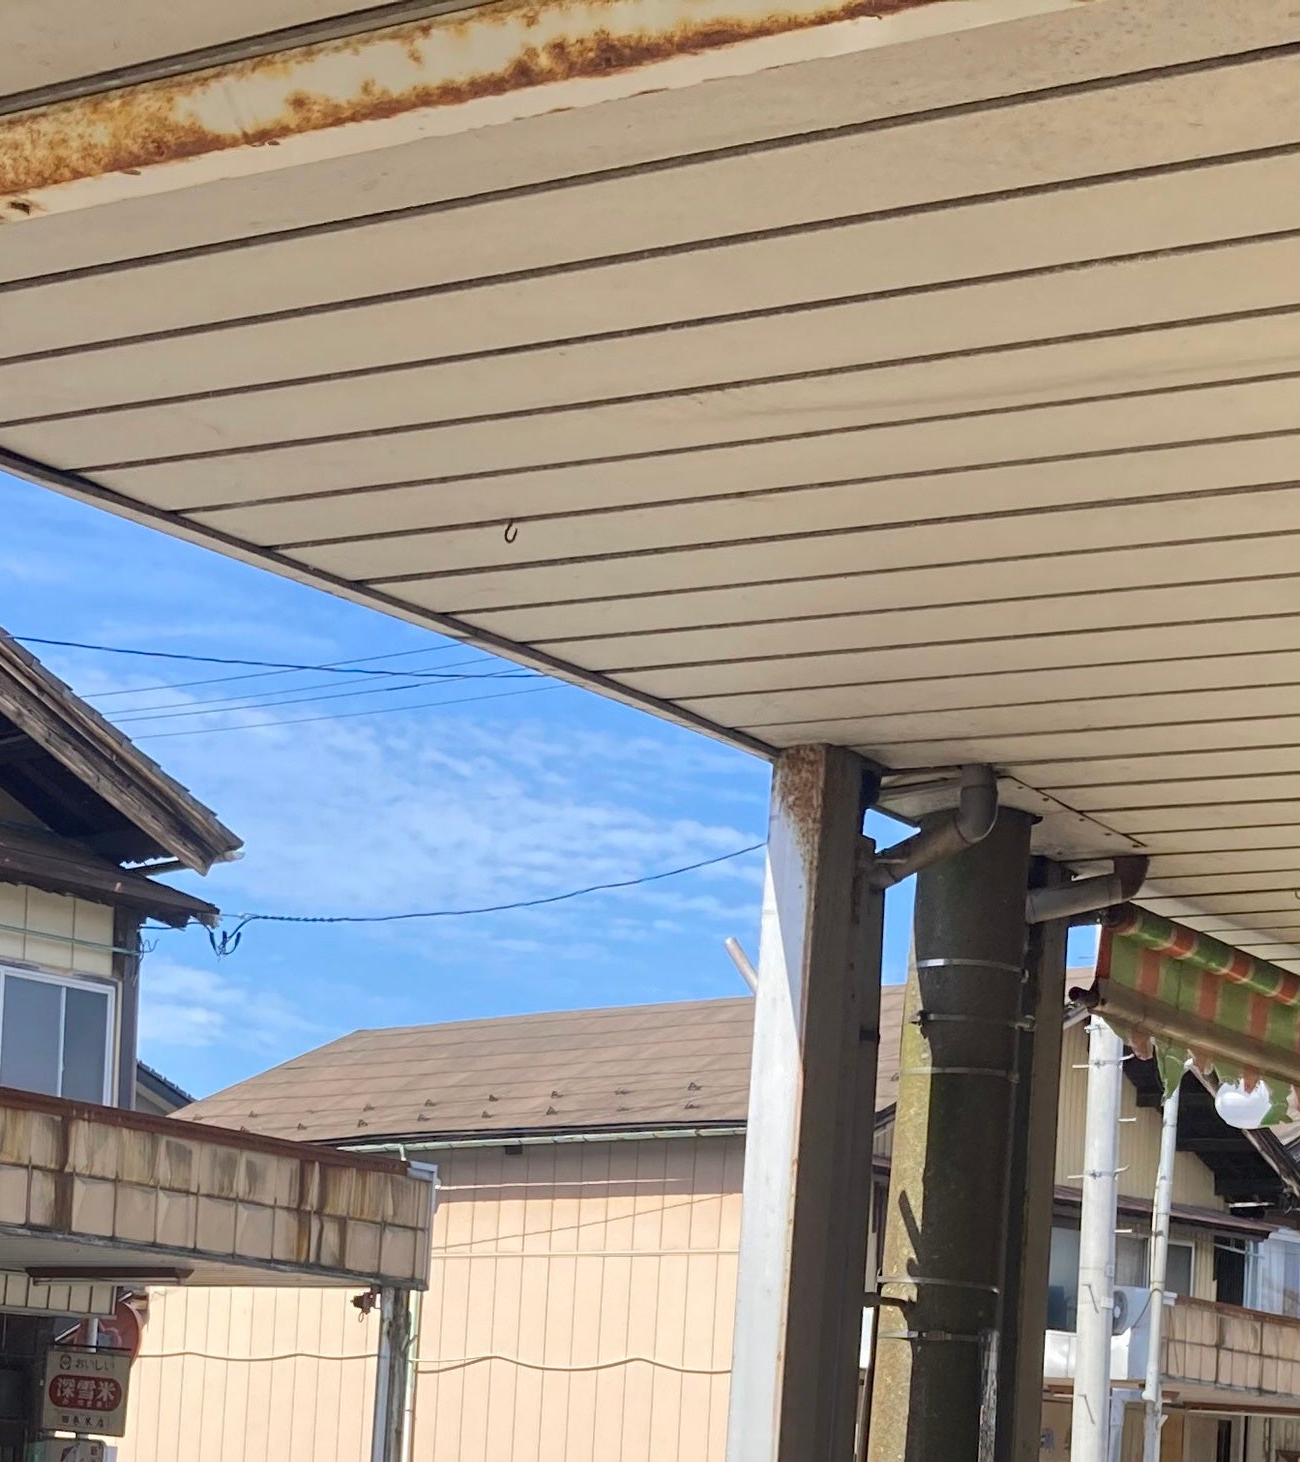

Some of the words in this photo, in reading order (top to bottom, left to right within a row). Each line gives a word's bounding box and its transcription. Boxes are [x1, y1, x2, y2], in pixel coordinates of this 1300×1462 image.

[75, 1357, 115, 1371] おいしい
[56, 1377, 117, 1402] 深雪米
